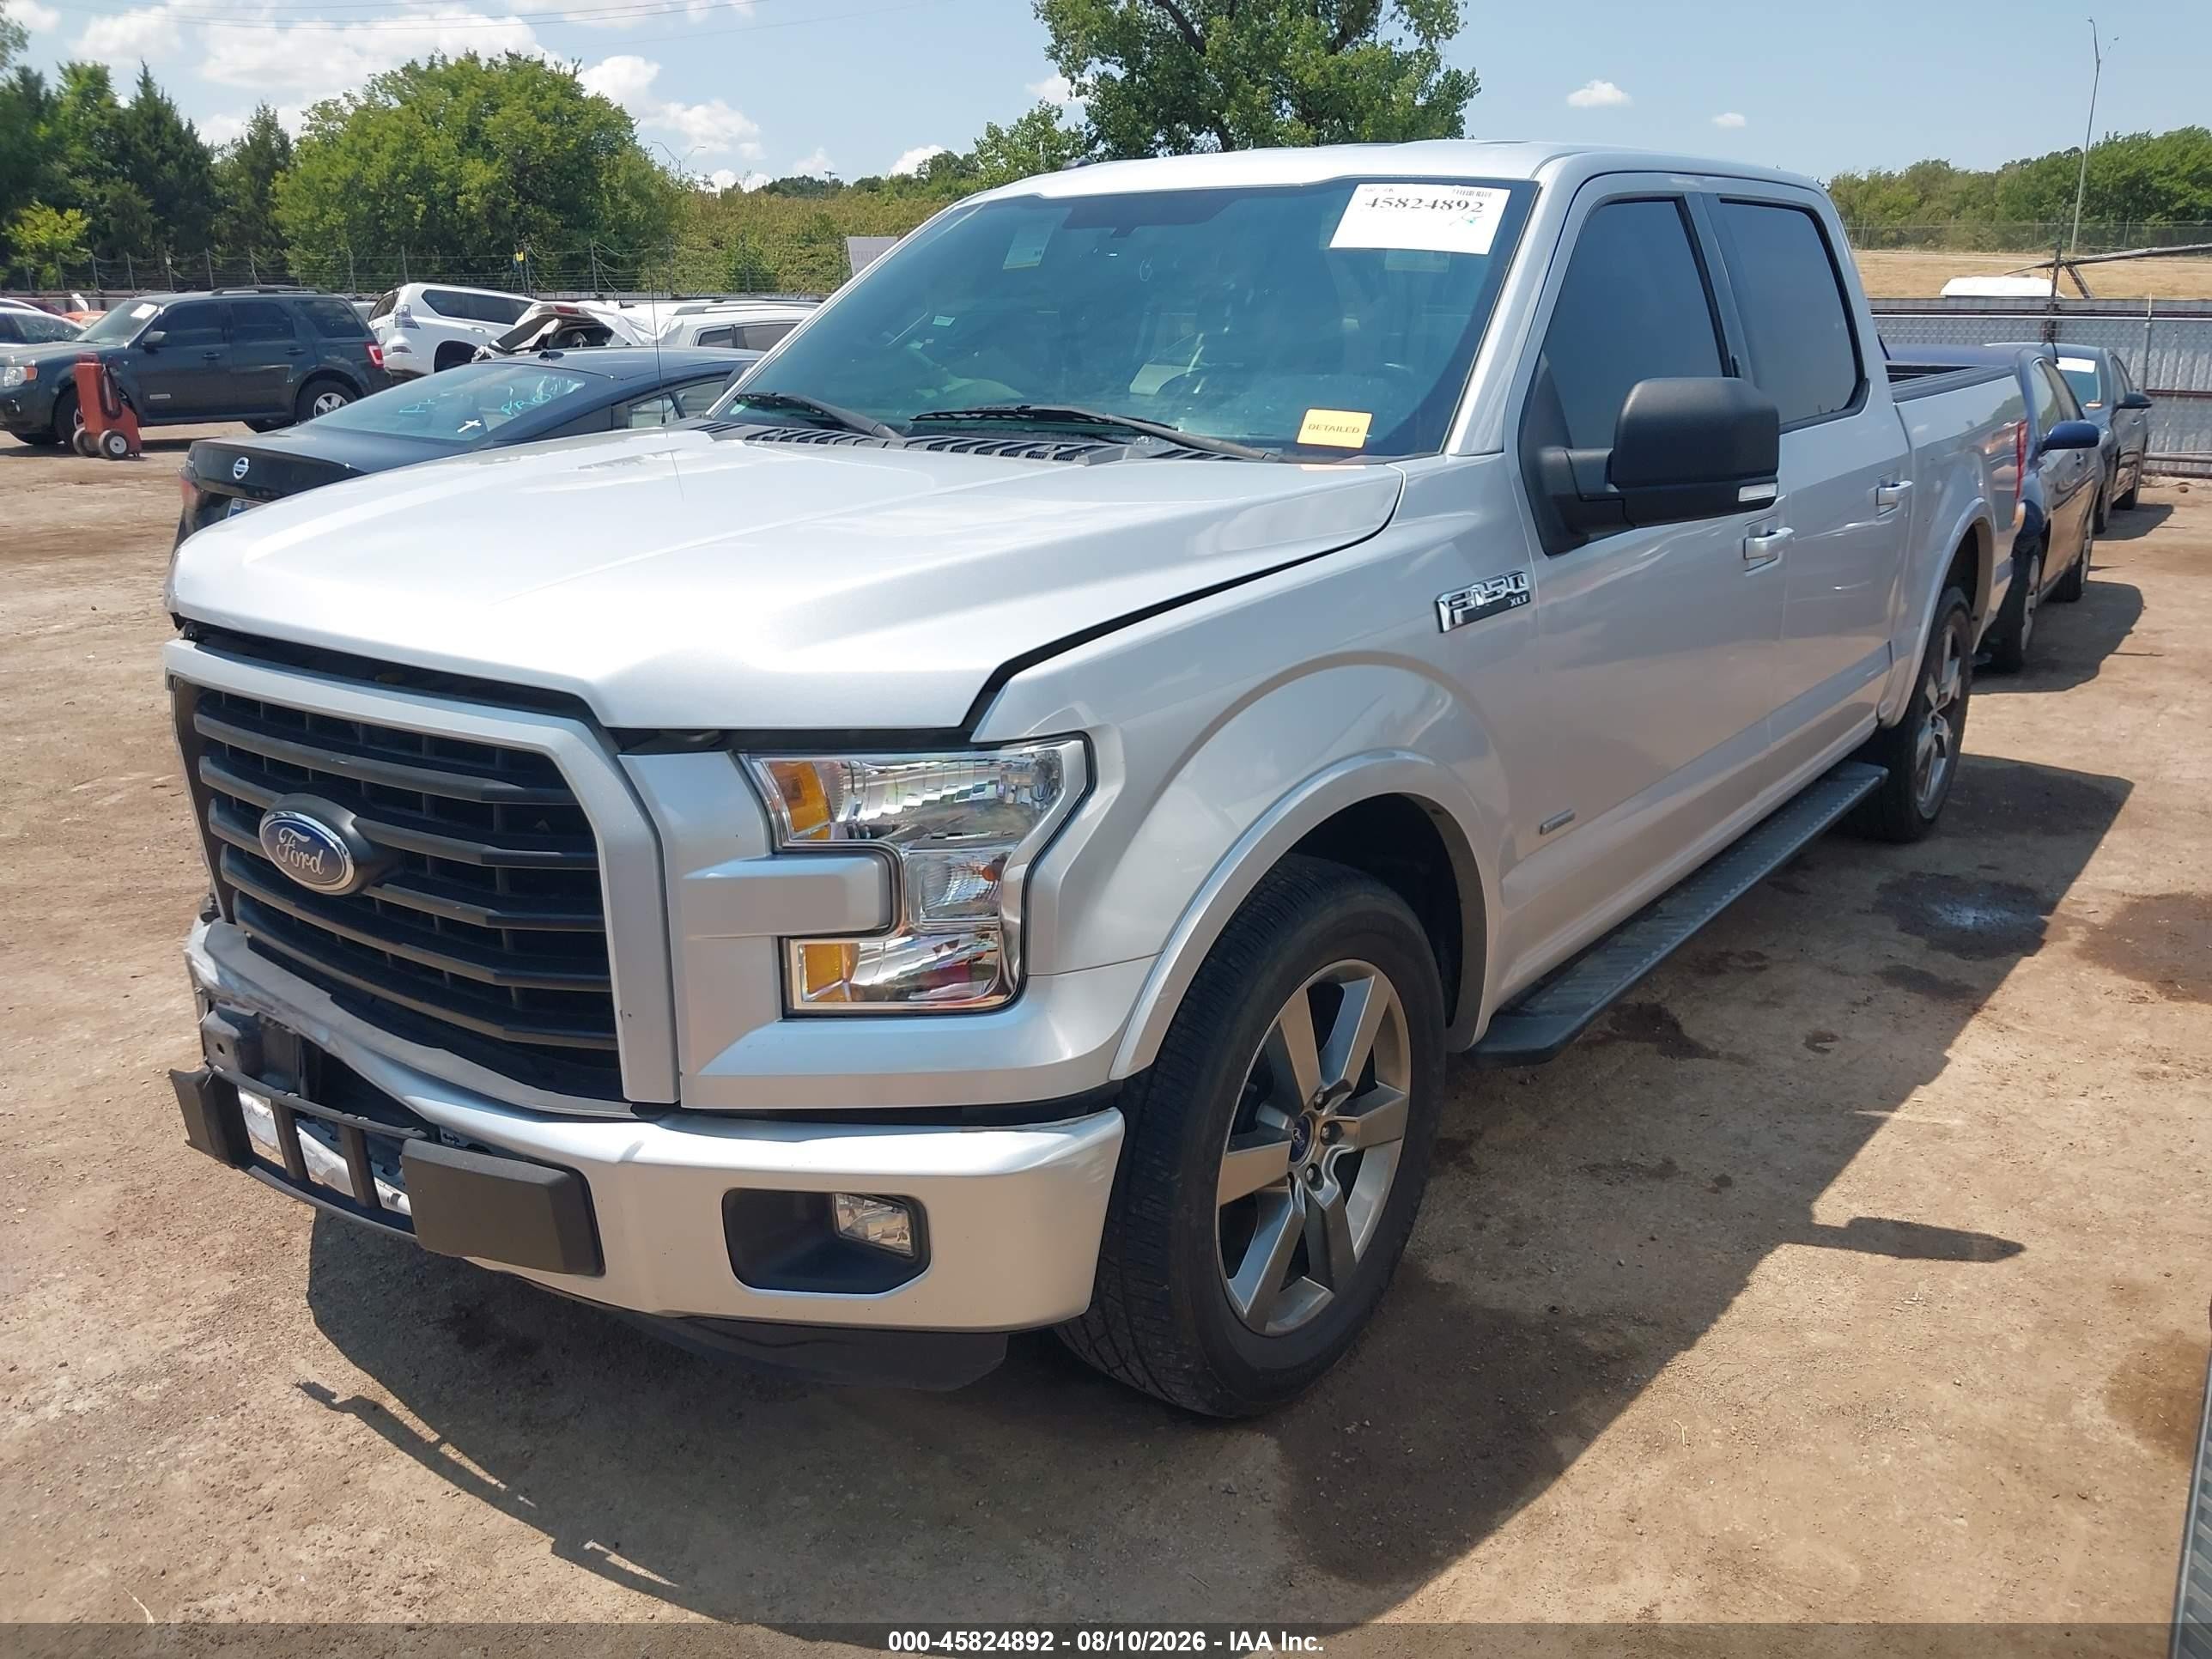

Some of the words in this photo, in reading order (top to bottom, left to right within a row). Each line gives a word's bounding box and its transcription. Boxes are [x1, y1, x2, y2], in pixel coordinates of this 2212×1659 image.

[1365, 198, 1485, 213] 45824892
[1308, 423, 1360, 433] DETAILED
[1510, 594, 1528, 606] XLT
[276, 827, 325, 875] Ford
